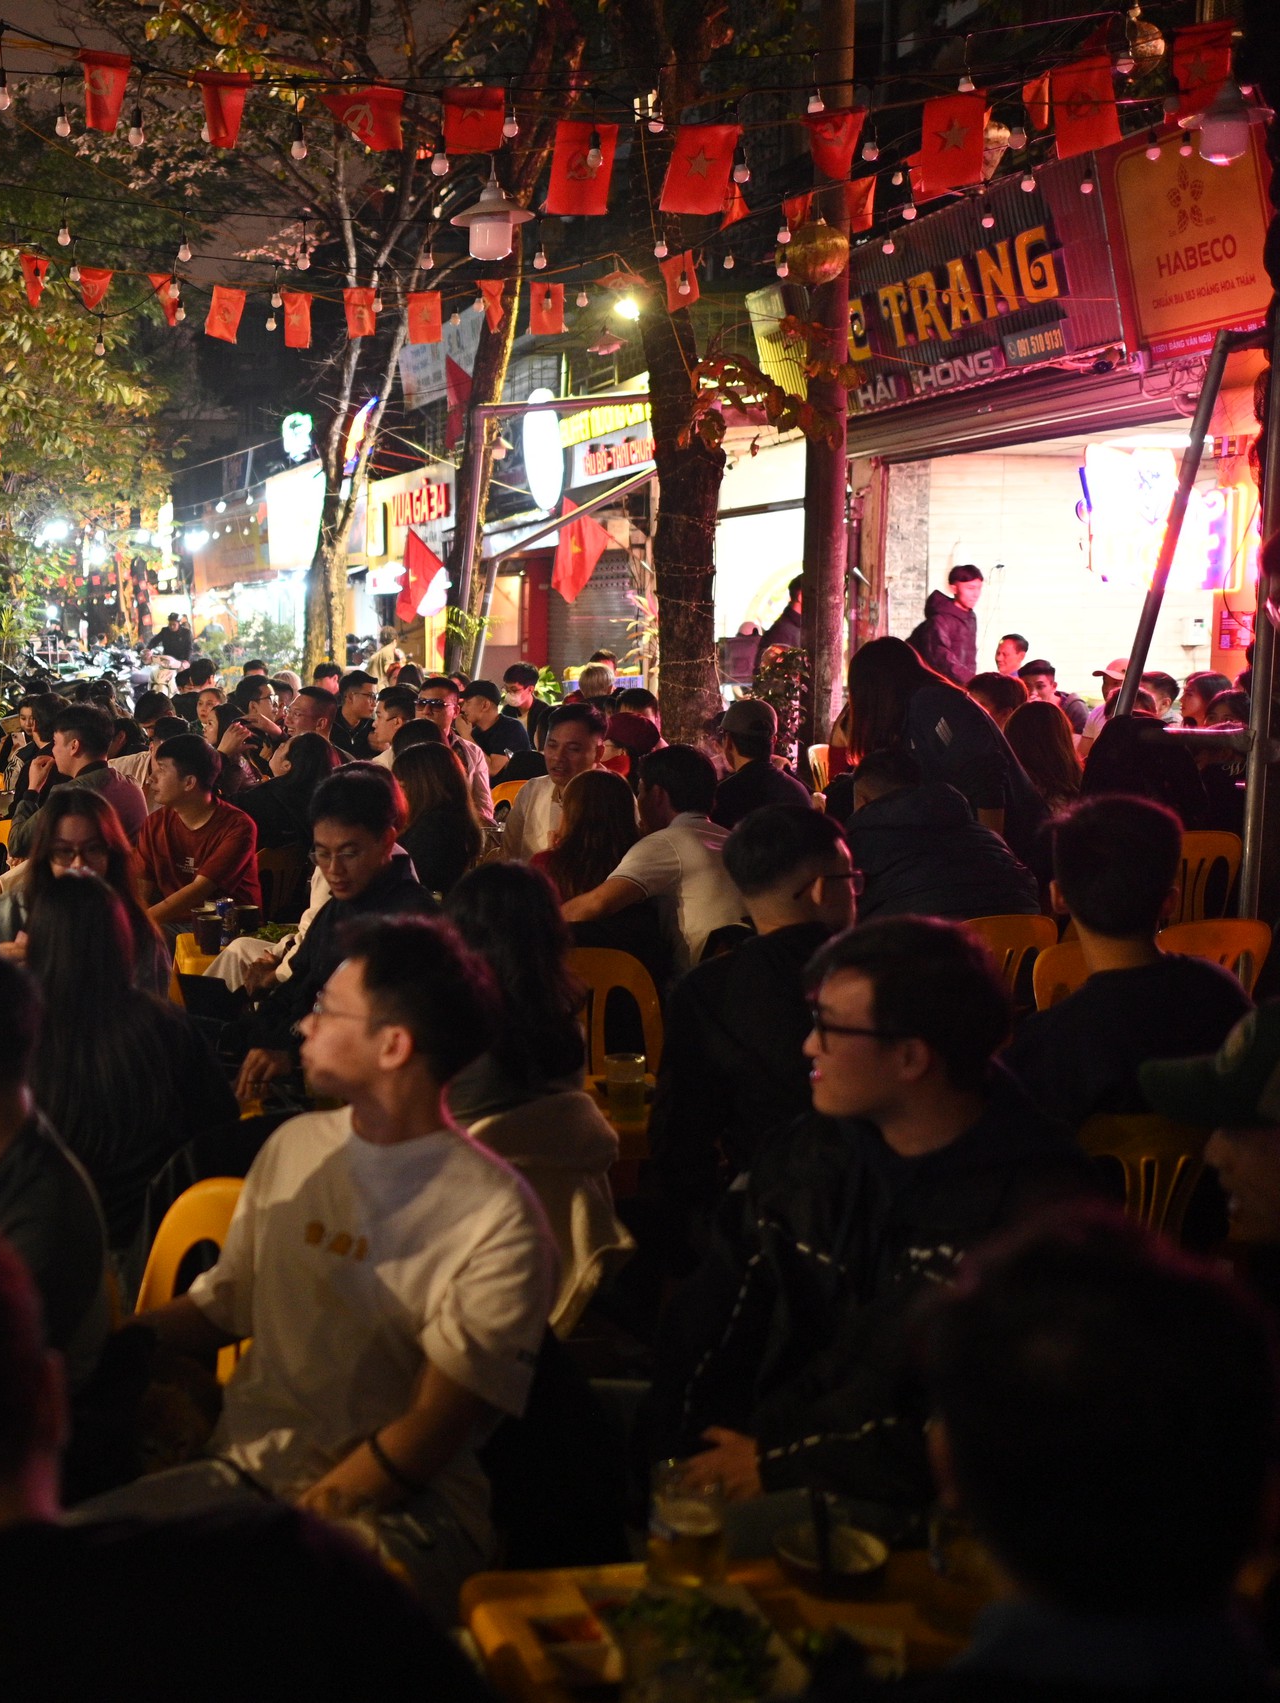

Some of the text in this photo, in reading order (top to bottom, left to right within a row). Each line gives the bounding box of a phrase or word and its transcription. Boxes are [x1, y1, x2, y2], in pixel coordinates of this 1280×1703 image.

[1156, 234, 1237, 278] HABECO
[878, 225, 1059, 349] TRANG
[1220, 281, 1236, 292] HOA
[1016, 328, 1063, 358] 091 510 9131
[858, 374, 898, 407] HẢI
[392, 477, 448, 527] VUA GÀ 34
